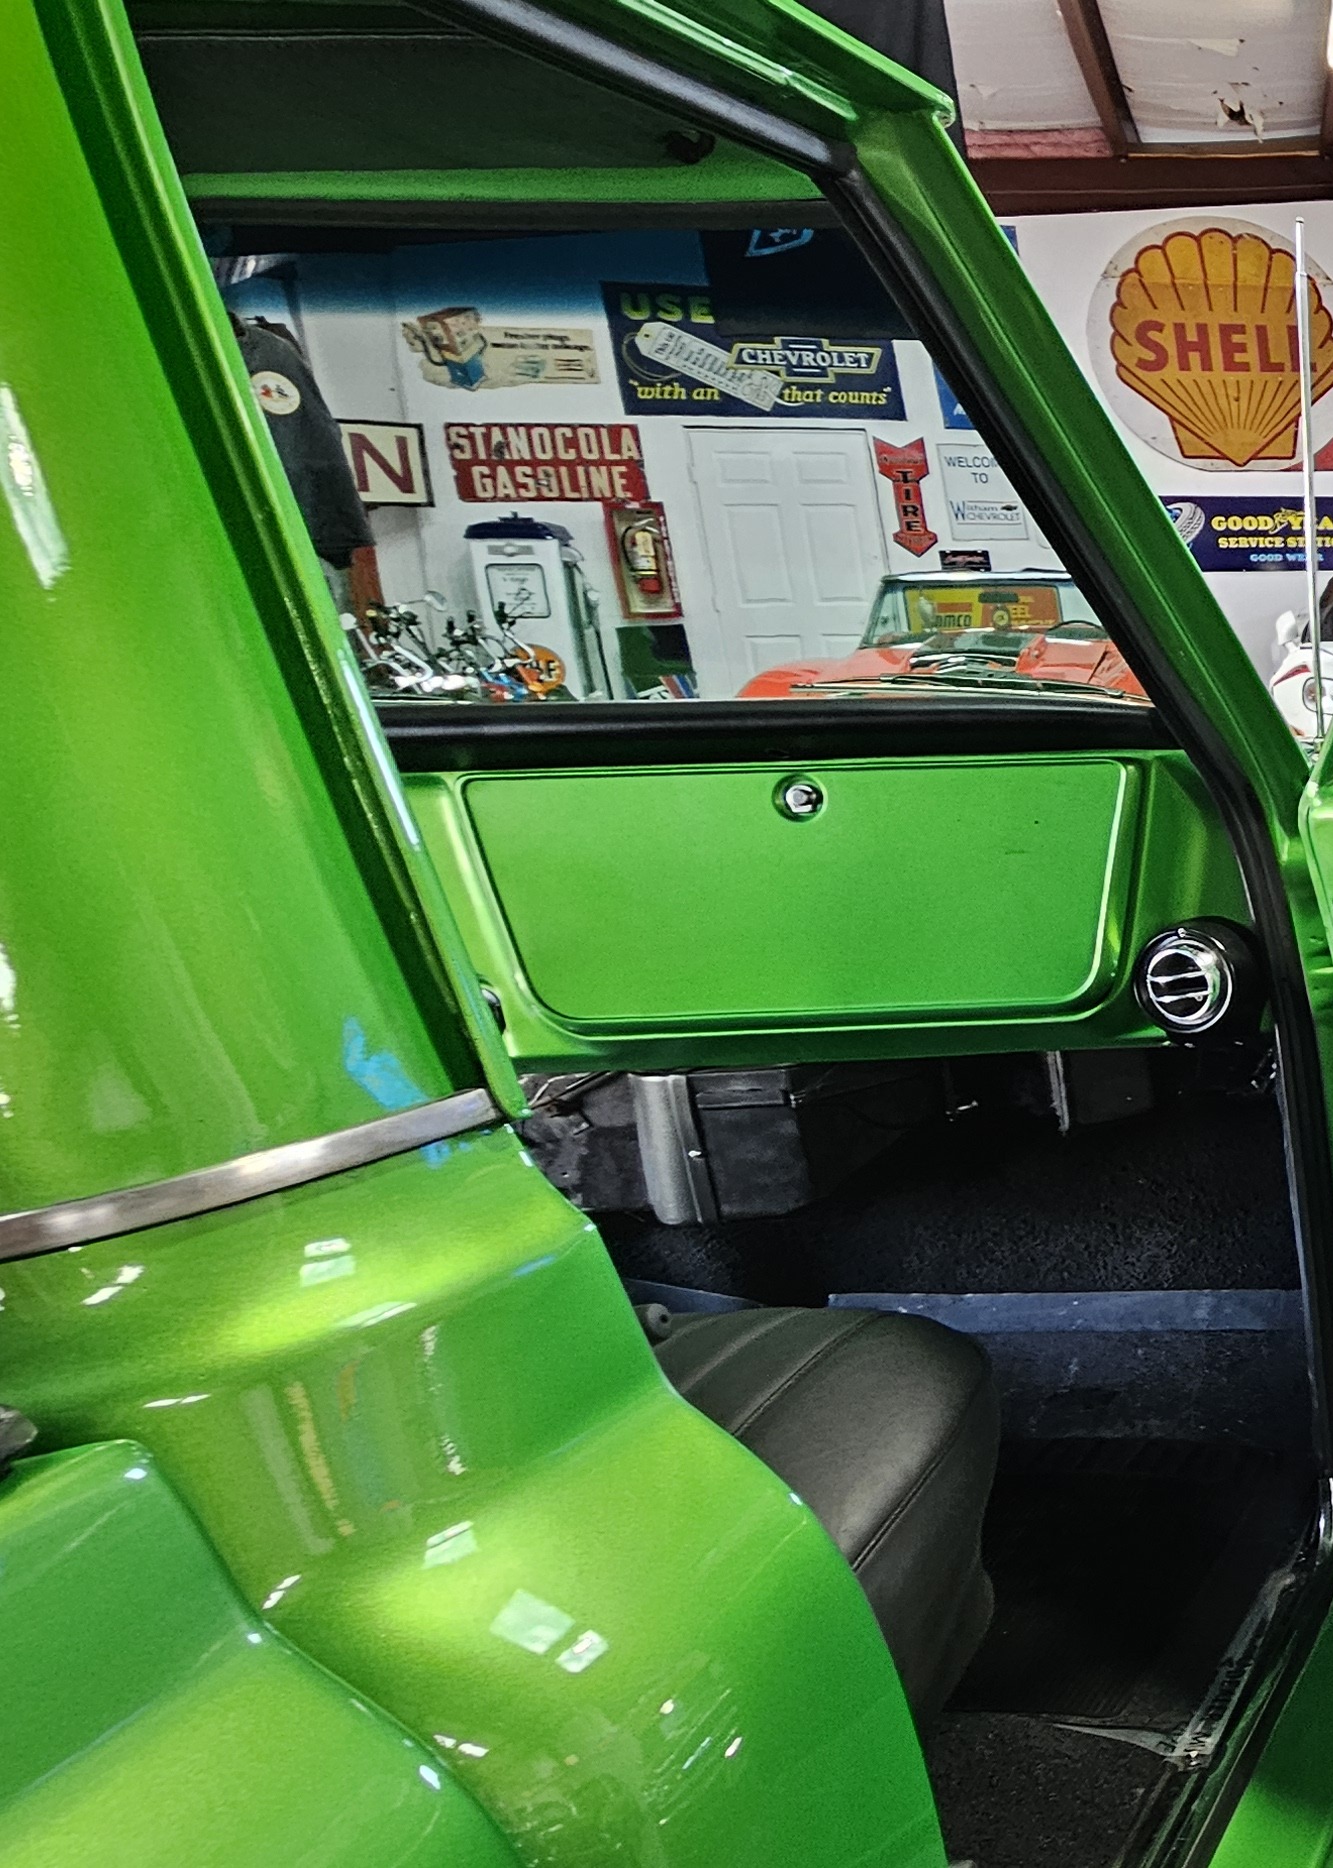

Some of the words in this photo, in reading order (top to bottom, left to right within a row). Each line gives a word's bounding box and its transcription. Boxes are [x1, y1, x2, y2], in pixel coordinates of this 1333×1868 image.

[1135, 319, 1317, 373] SHELL
[742, 348, 870, 368] CHEVROLET
[692, 388, 719, 400] an
[783, 386, 824, 403] that
[451, 426, 640, 461] STANOCOLA
[944, 456, 1000, 468] WELCO
[471, 465, 632, 499] GASOLINE
[971, 472, 989, 483] TO
[895, 470, 921, 532] TIRE
[1218, 537, 1284, 549] SERVICE
[1250, 553, 1283, 562] GOOD
